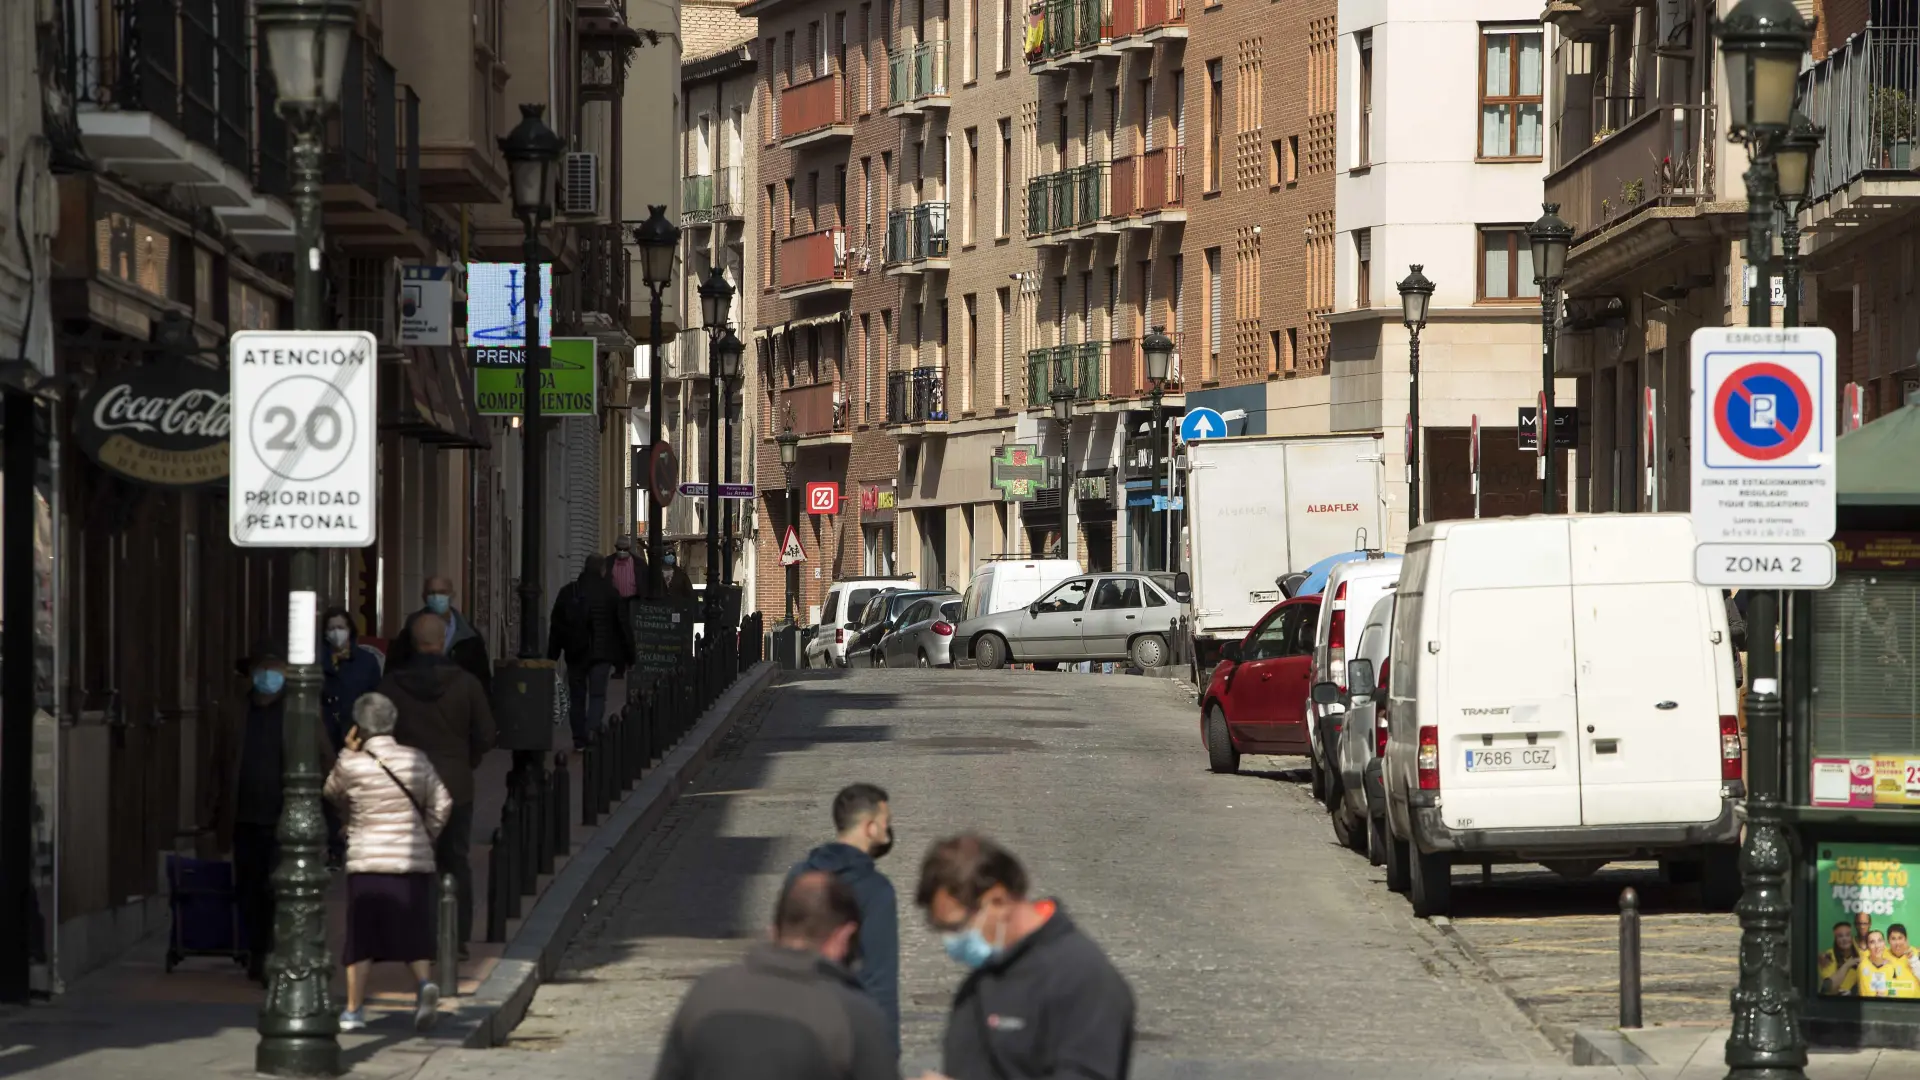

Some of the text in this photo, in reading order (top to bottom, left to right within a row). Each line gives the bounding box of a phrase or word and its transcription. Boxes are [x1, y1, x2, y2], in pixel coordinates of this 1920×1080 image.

[243, 346, 365, 365] ATENCIÓN
[93, 384, 230, 437] Coca-Cola
[263, 406, 343, 451] 20
[245, 491, 361, 506] PRIORIDAD
[1307, 503, 1359, 514] ALBAFLEX
[246, 514, 358, 530] PEATONAL
[1725, 557, 1802, 572] ZONA 2
[1461, 707, 1511, 716] TRANSIT
[1475, 750, 1550, 766] 7686 CGZ
[1836, 857, 1900, 870] CUANDO
[1828, 870, 1883, 886] JUEGAS
[1832, 885, 1904, 901] JUGAMOS
[1842, 900, 1894, 915] TODOS
